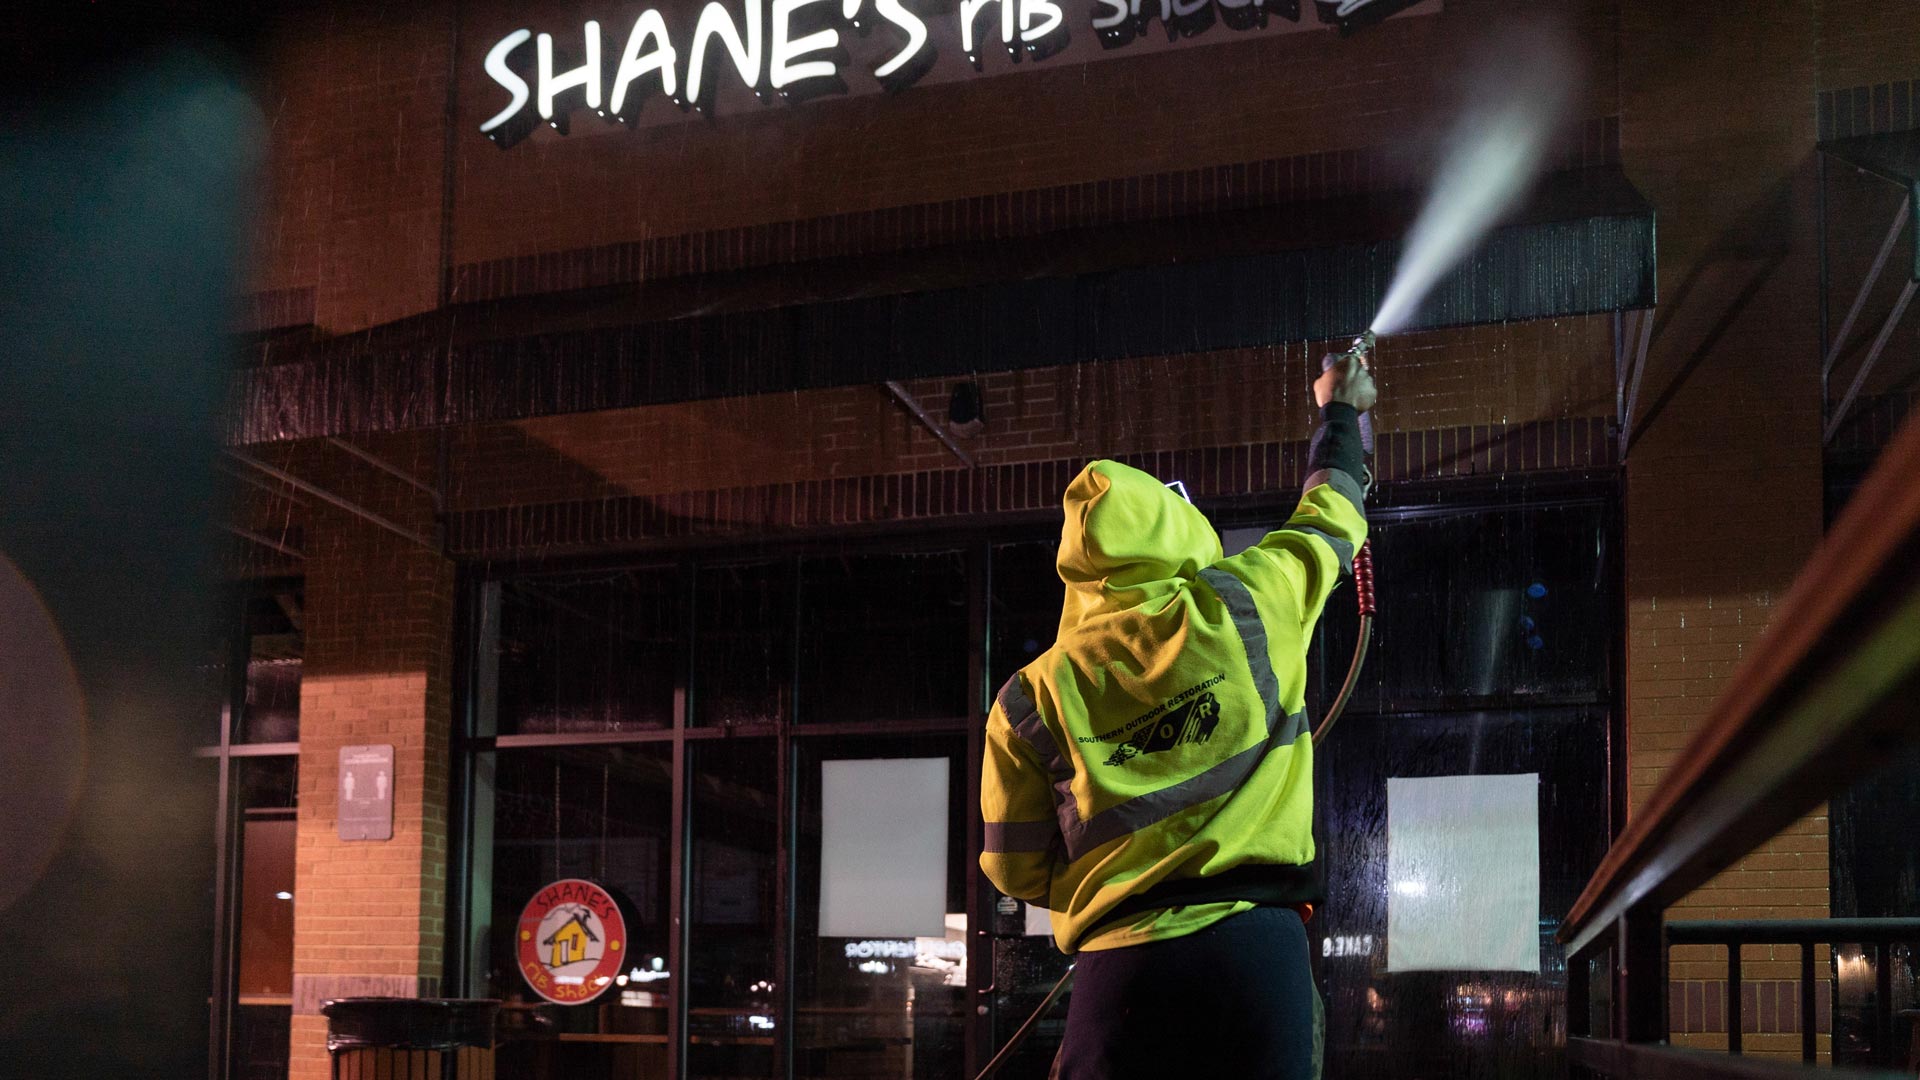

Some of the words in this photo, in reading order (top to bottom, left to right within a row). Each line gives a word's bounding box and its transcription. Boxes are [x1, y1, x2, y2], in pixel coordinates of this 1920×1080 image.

[480, 0, 927, 132] SHANE'S
[1078, 728, 1125, 744] SOUTHERN
[1126, 704, 1167, 731] OUTDOOR
[1168, 673, 1226, 708] RESTORATION
[537, 882, 617, 919] SHANE'S
